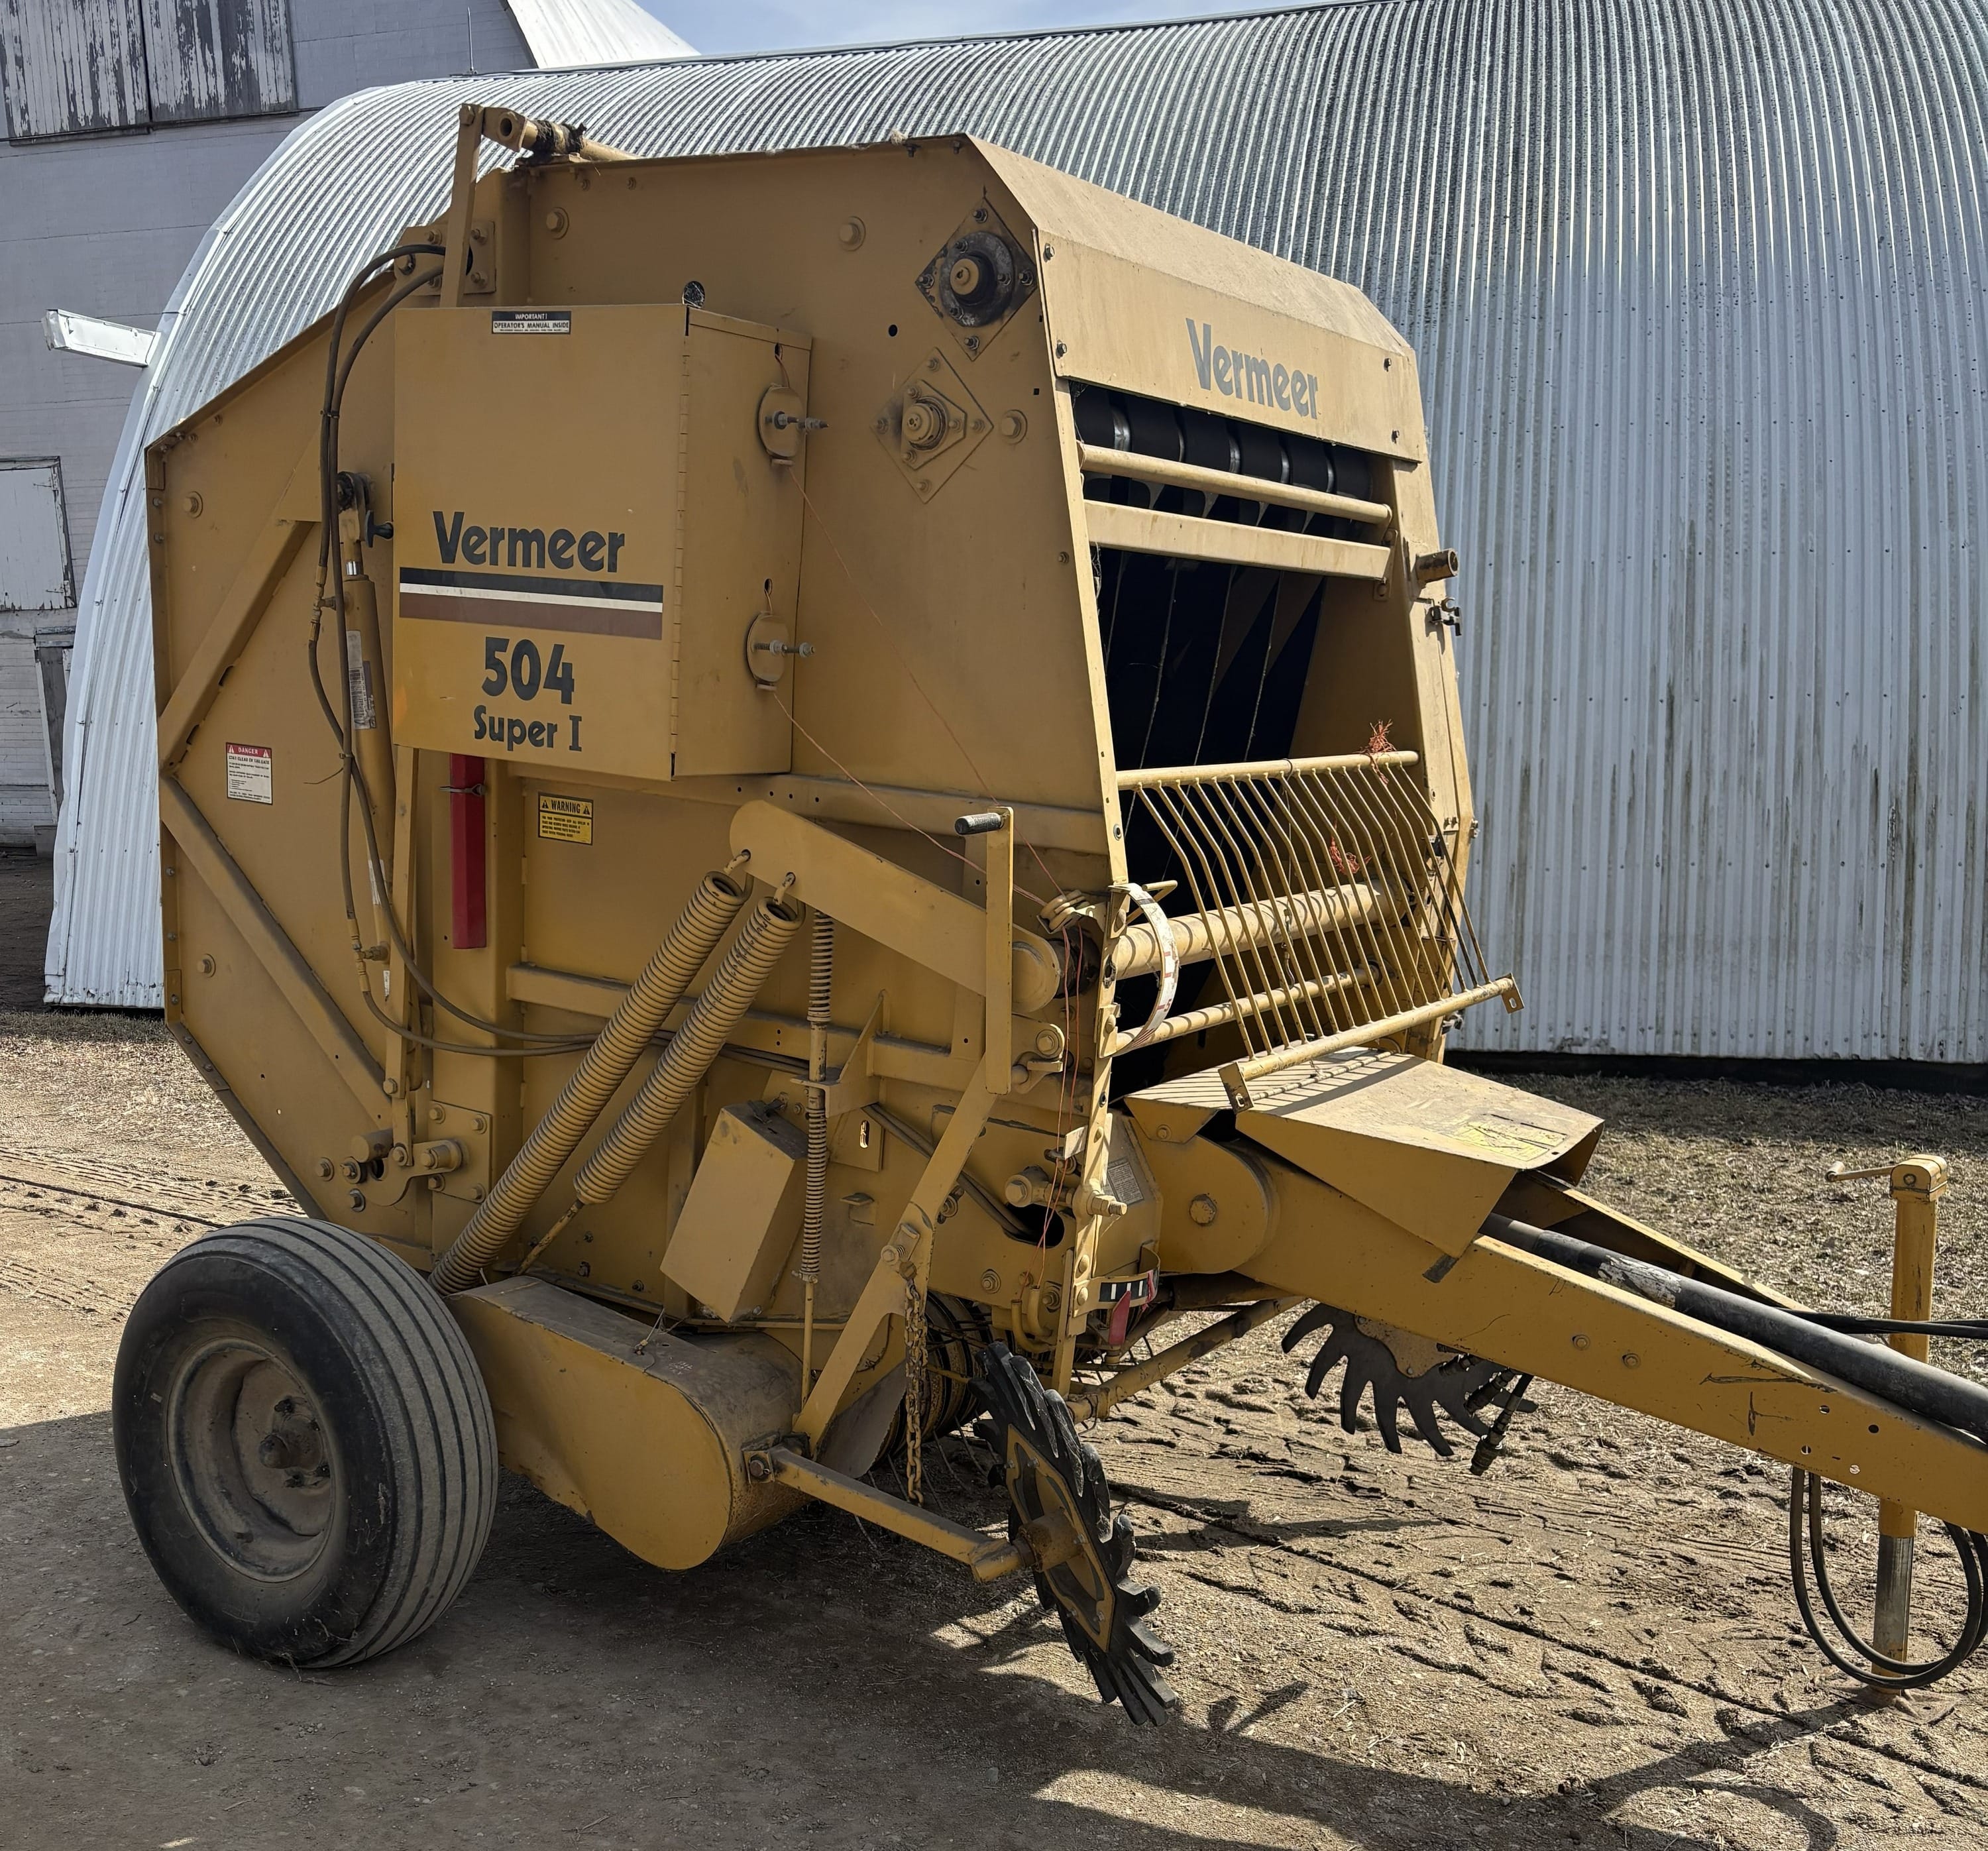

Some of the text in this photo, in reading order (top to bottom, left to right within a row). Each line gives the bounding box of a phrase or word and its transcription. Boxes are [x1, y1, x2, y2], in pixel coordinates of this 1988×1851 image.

[1186, 317, 1318, 420] Vermeer
[433, 511, 625, 573] Vermeer
[482, 636, 575, 704] 504
[473, 704, 582, 752] Super I
[551, 799, 580, 813] WARNING
